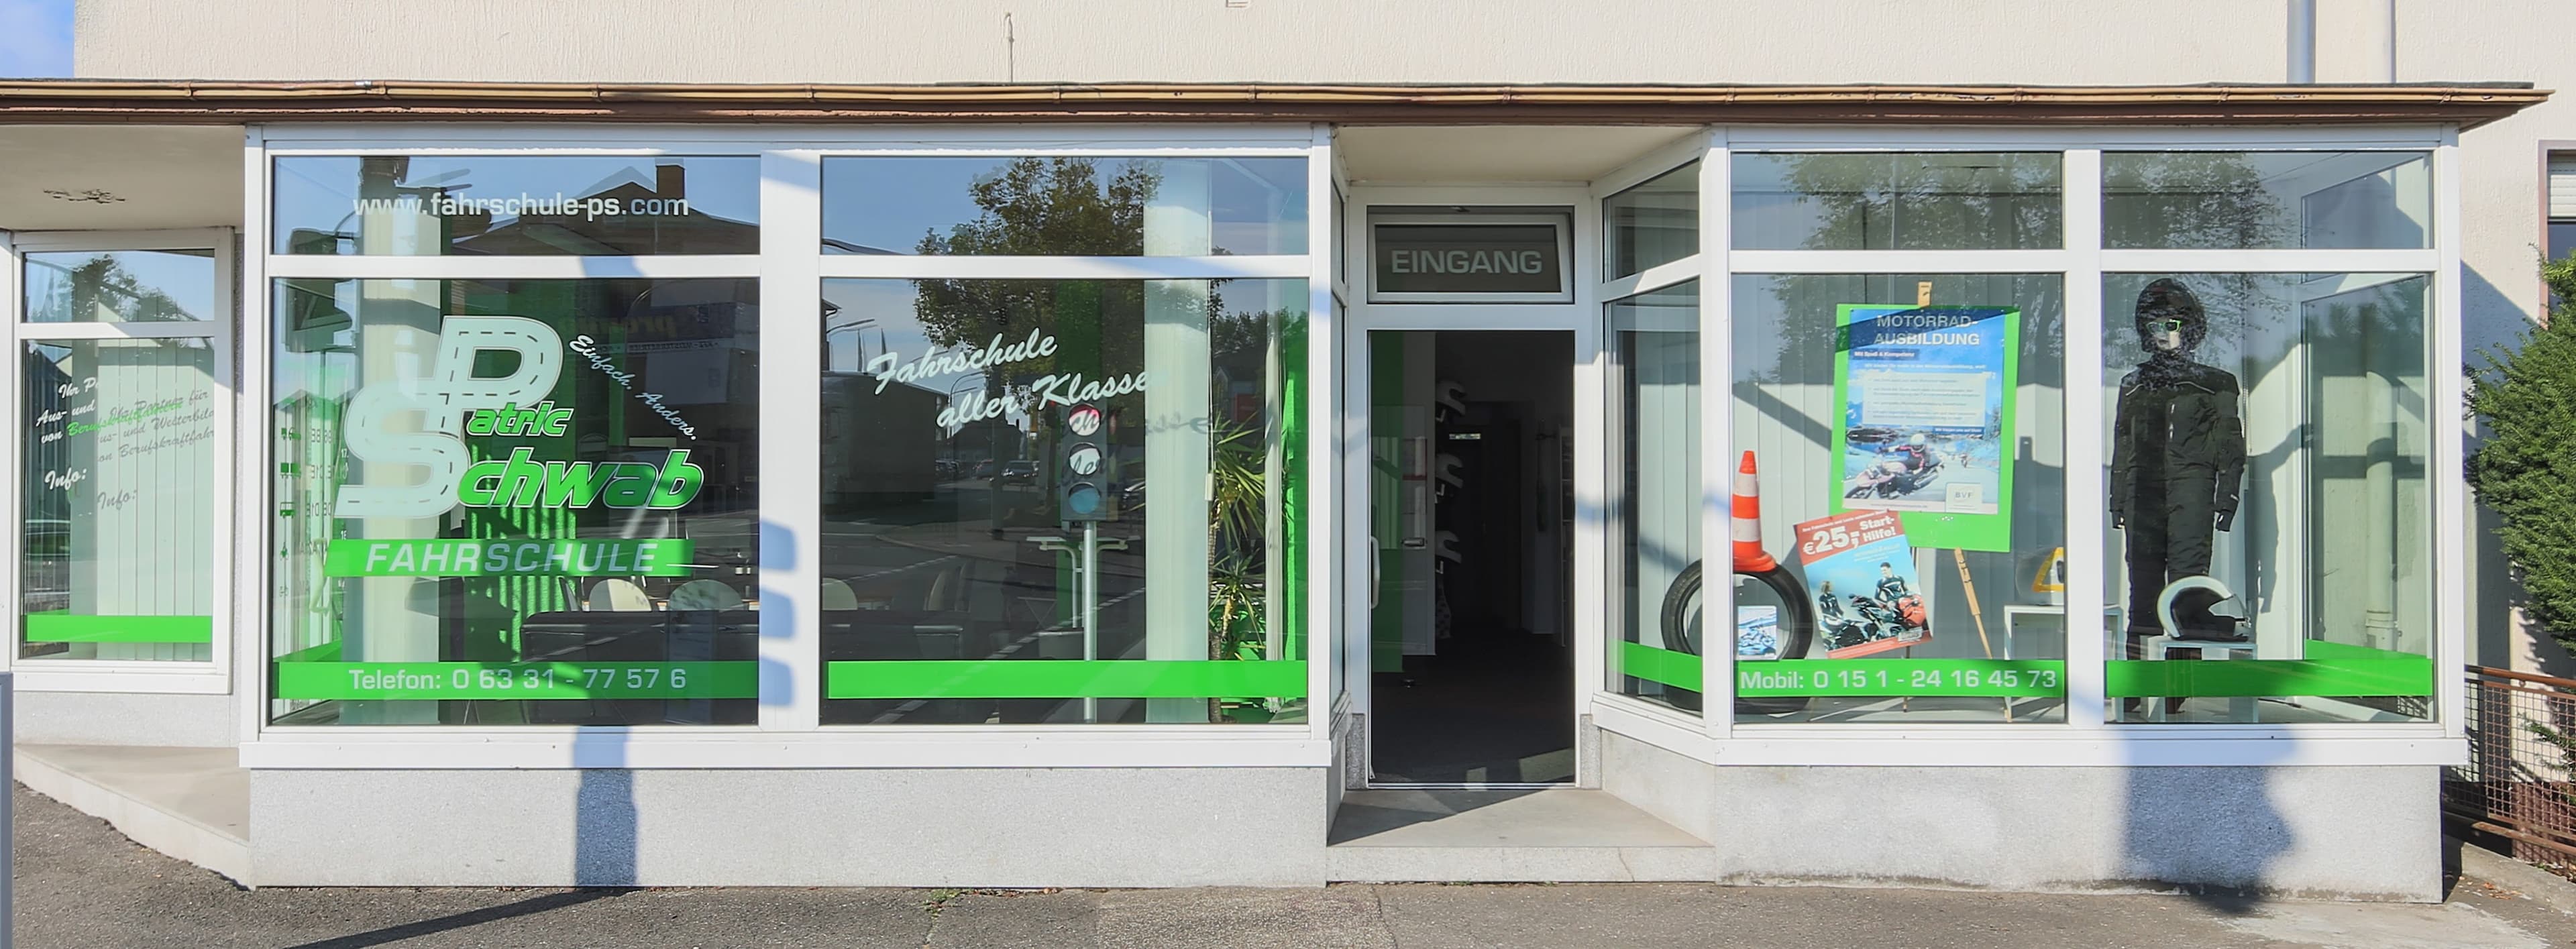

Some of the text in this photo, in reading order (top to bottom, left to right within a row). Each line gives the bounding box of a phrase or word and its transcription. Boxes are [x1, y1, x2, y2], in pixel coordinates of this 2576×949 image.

[353, 191, 690, 221] www.fahrschule-ps.com
[1391, 249, 1543, 274] EINGANG
[1876, 315, 1979, 328] MOTORRAD-
[1873, 332, 1980, 346] AUSBILDUNG
[867, 327, 1059, 396] Fahrschule
[58, 382, 80, 399] Ihr
[569, 335, 697, 441] Einfach. Anders.
[36, 399, 96, 427] Aus- und
[936, 389, 1019, 429] aller
[40, 431, 64, 445] von
[44, 467, 87, 490] Info:
[1859, 515, 1895, 531] Start-
[1863, 526, 1896, 543] Hilfe!
[365, 544, 659, 573] FAHRSCHULE
[349, 669, 441, 689] Telefon:
[452, 669, 470, 689] 0
[478, 669, 513, 689] 63
[523, 669, 554, 689] 31
[583, 669, 614, 689] 77
[627, 669, 661, 689] 57
[670, 669, 687, 689] 6
[1740, 671, 1805, 689] Mobil:
[1813, 671, 1829, 688] 0
[1838, 671, 1867, 688] 15
[1876, 671, 1888, 688] 1
[1911, 670, 1942, 687] 24
[1951, 670, 1980, 687] 16
[1988, 670, 2018, 687] 45
[2027, 670, 2057, 687] 73
